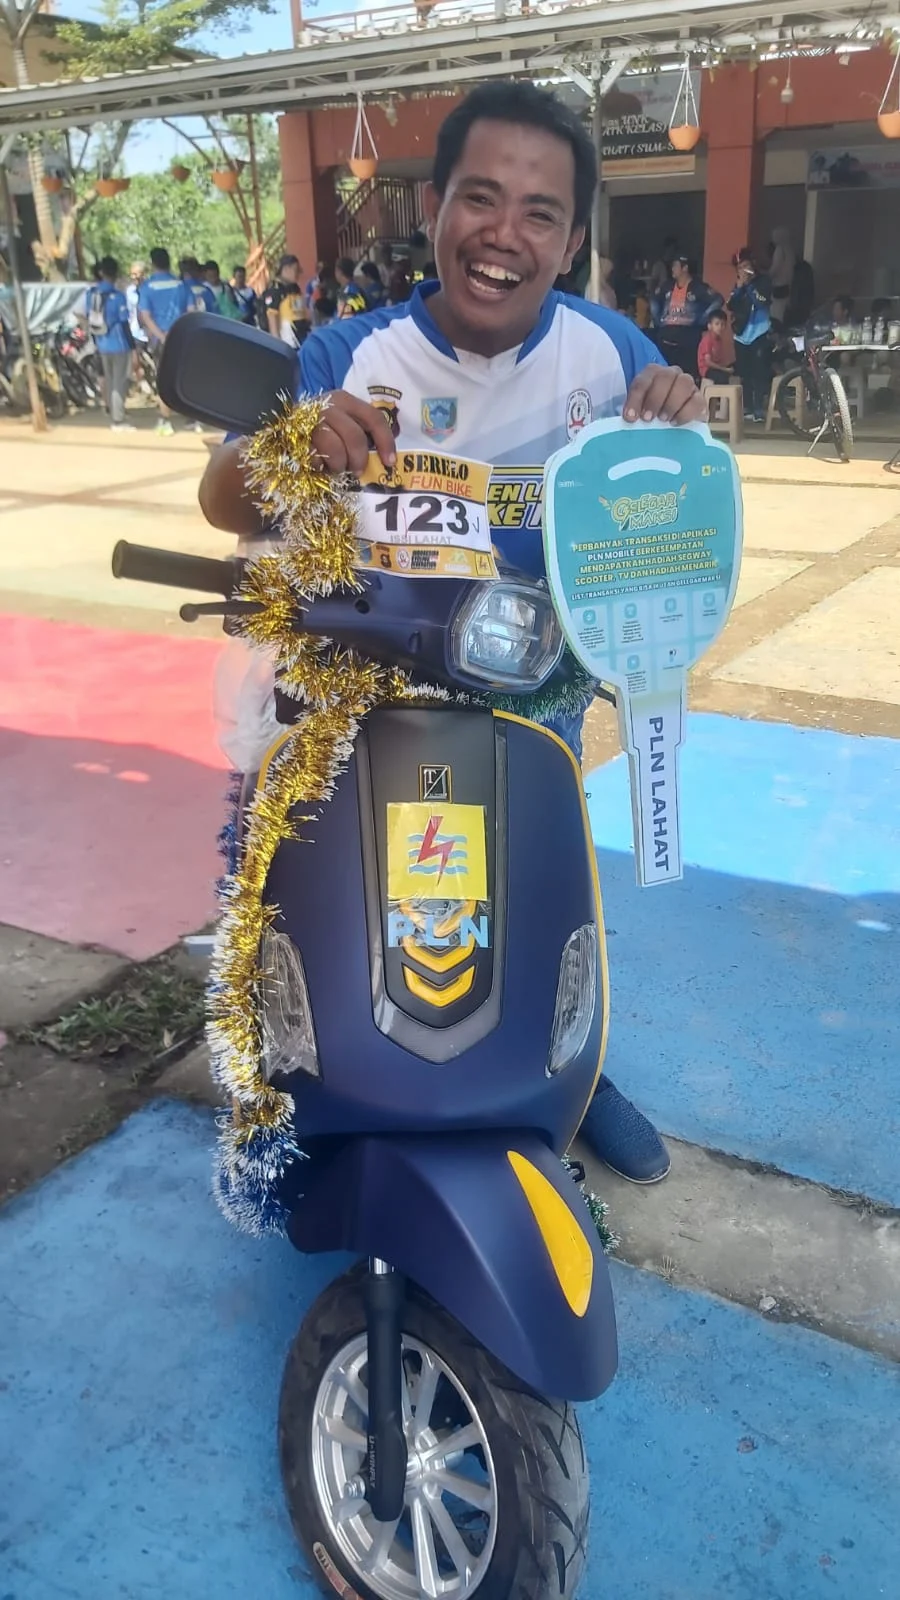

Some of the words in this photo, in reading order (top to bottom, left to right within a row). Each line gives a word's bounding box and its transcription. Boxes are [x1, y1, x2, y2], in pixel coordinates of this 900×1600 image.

[403, 454, 469, 481] SERELO
[410, 475, 443, 490] FUN
[446, 480, 472, 498] BIKE
[488, 484, 522, 501] EN
[375, 495, 470, 535] 123
[487, 503, 526, 526] KE
[624, 508, 678, 531] MAKSI
[414, 535, 452, 545] LAHAT
[572, 541, 623, 552] PERBANYAK
[625, 534, 671, 546] TRANSAKSI
[672, 532, 680, 540] DI
[681, 528, 717, 539] APLIKASI
[588, 552, 604, 562] PLN
[604, 548, 635, 560] MOBILE
[635, 540, 704, 556] BERKESEMPATAN
[580, 559, 646, 575] MENDAPATKAN
[645, 555, 677, 566] HADIAH
[678, 550, 712, 561] SEGWAY
[618, 571, 630, 581] TV
[630, 569, 649, 579] DAN
[649, 565, 681, 577] HADIAH
[681, 559, 717, 572] MENARIK
[586, 588, 620, 599] TRANSAKSI
[620, 586, 638, 594] YANG
[649, 716, 665, 773] PLN
[651, 780, 669, 871] LAHAT
[388, 911, 489, 948] PLN
